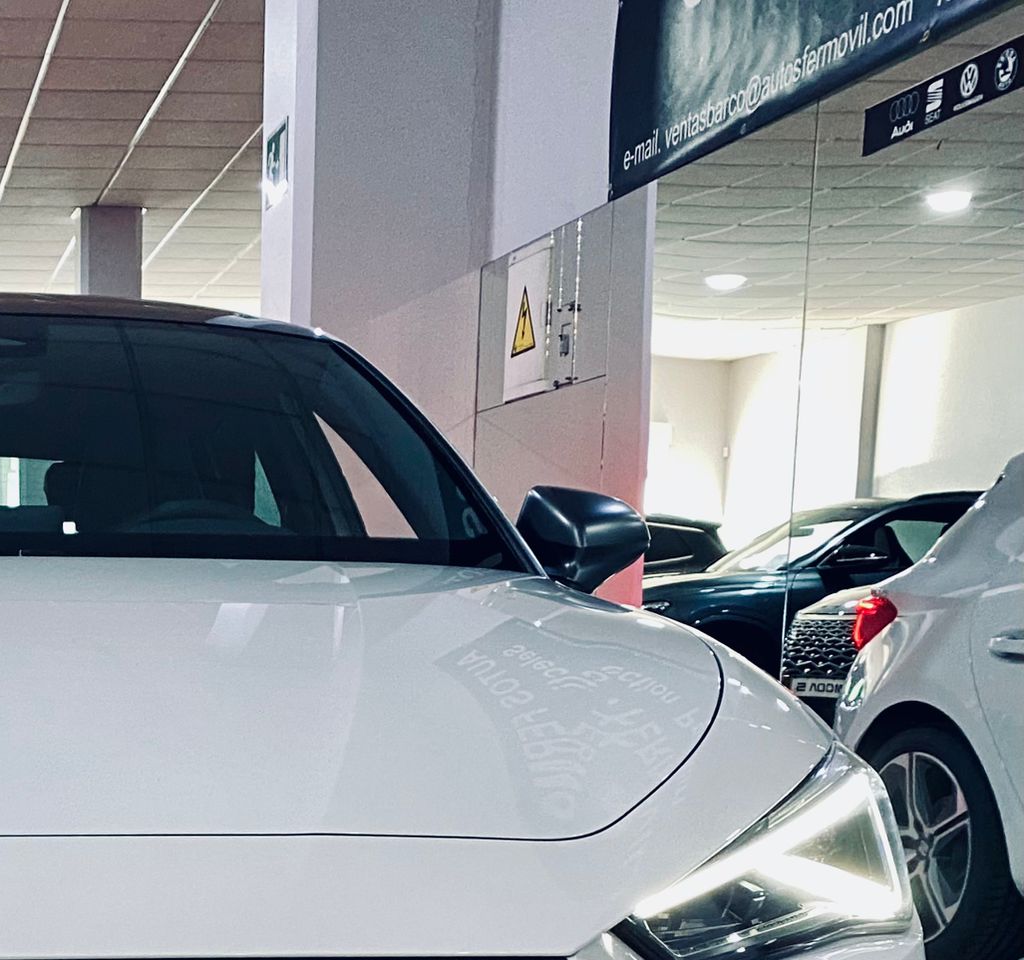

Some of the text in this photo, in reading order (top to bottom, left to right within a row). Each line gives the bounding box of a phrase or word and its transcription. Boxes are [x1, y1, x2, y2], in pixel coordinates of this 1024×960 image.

[623, 128, 661, 170] e-mail.
[665, 0, 914, 148] ventasbarco@autosfermovil.com
[890, 120, 914, 139] Audi
